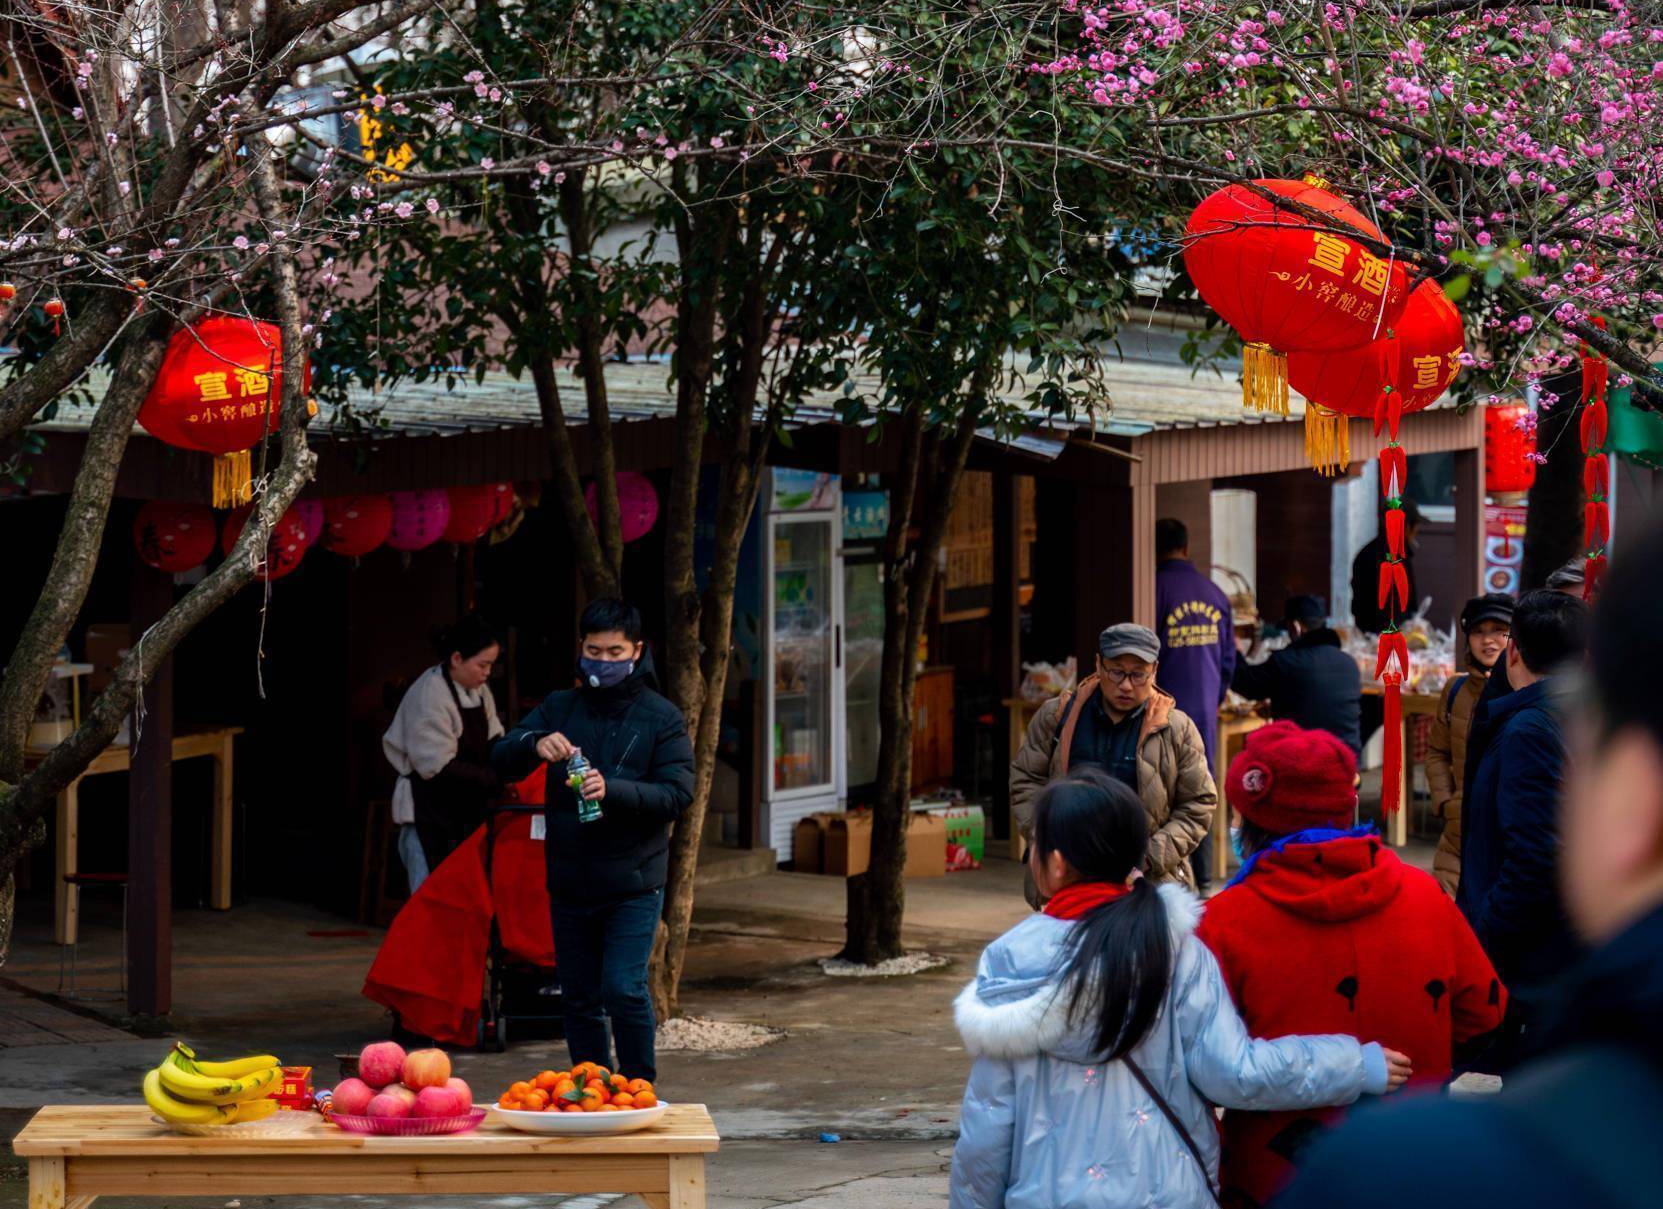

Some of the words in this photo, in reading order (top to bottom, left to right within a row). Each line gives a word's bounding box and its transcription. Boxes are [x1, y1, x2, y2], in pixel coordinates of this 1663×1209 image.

[1308, 232, 1389, 296] 宣酒
[1291, 272, 1375, 322] 小窖酿造
[193, 364, 269, 402] 宣酒
